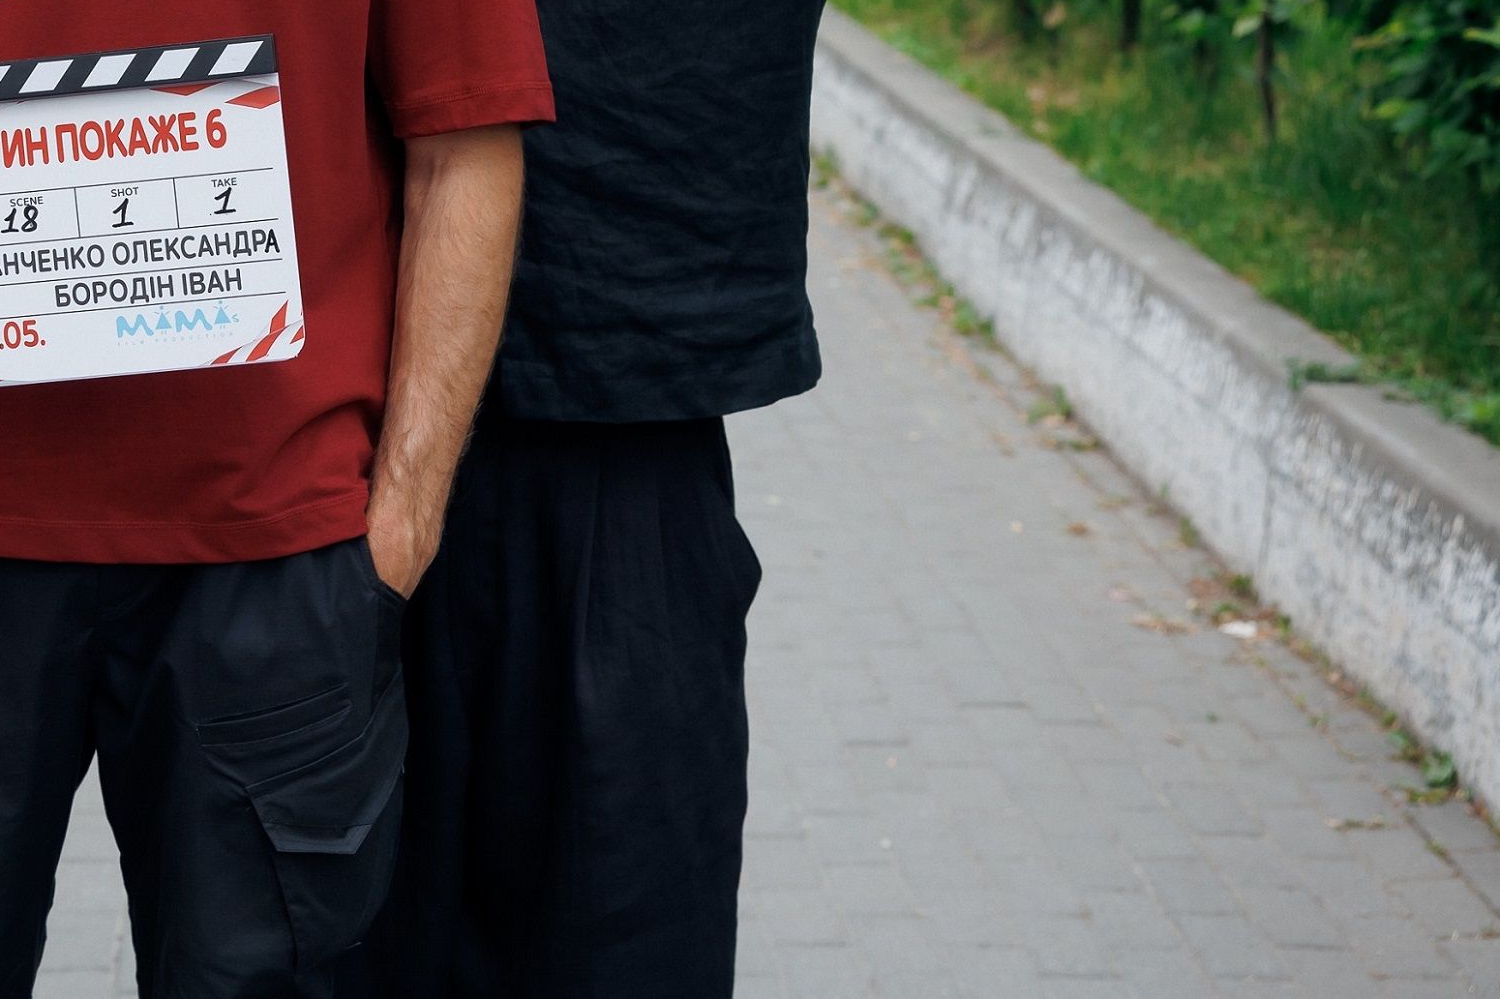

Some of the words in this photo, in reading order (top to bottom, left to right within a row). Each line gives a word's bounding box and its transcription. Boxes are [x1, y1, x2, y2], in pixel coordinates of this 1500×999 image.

[54, 113, 200, 165] ПОКАЖЕ
[205, 108, 228, 149] 6
[110, 186, 140, 198] SHOT
[210, 177, 238, 188] TAKE
[9, 195, 44, 207] SCENE
[111, 198, 135, 228] 1
[213, 187, 237, 215] 1
[0, 205, 39, 234] 18
[112, 228, 281, 265] ОЛЕКСАНДРА
[54, 275, 175, 308] БОРОДІН
[182, 268, 243, 295] ІВАН
